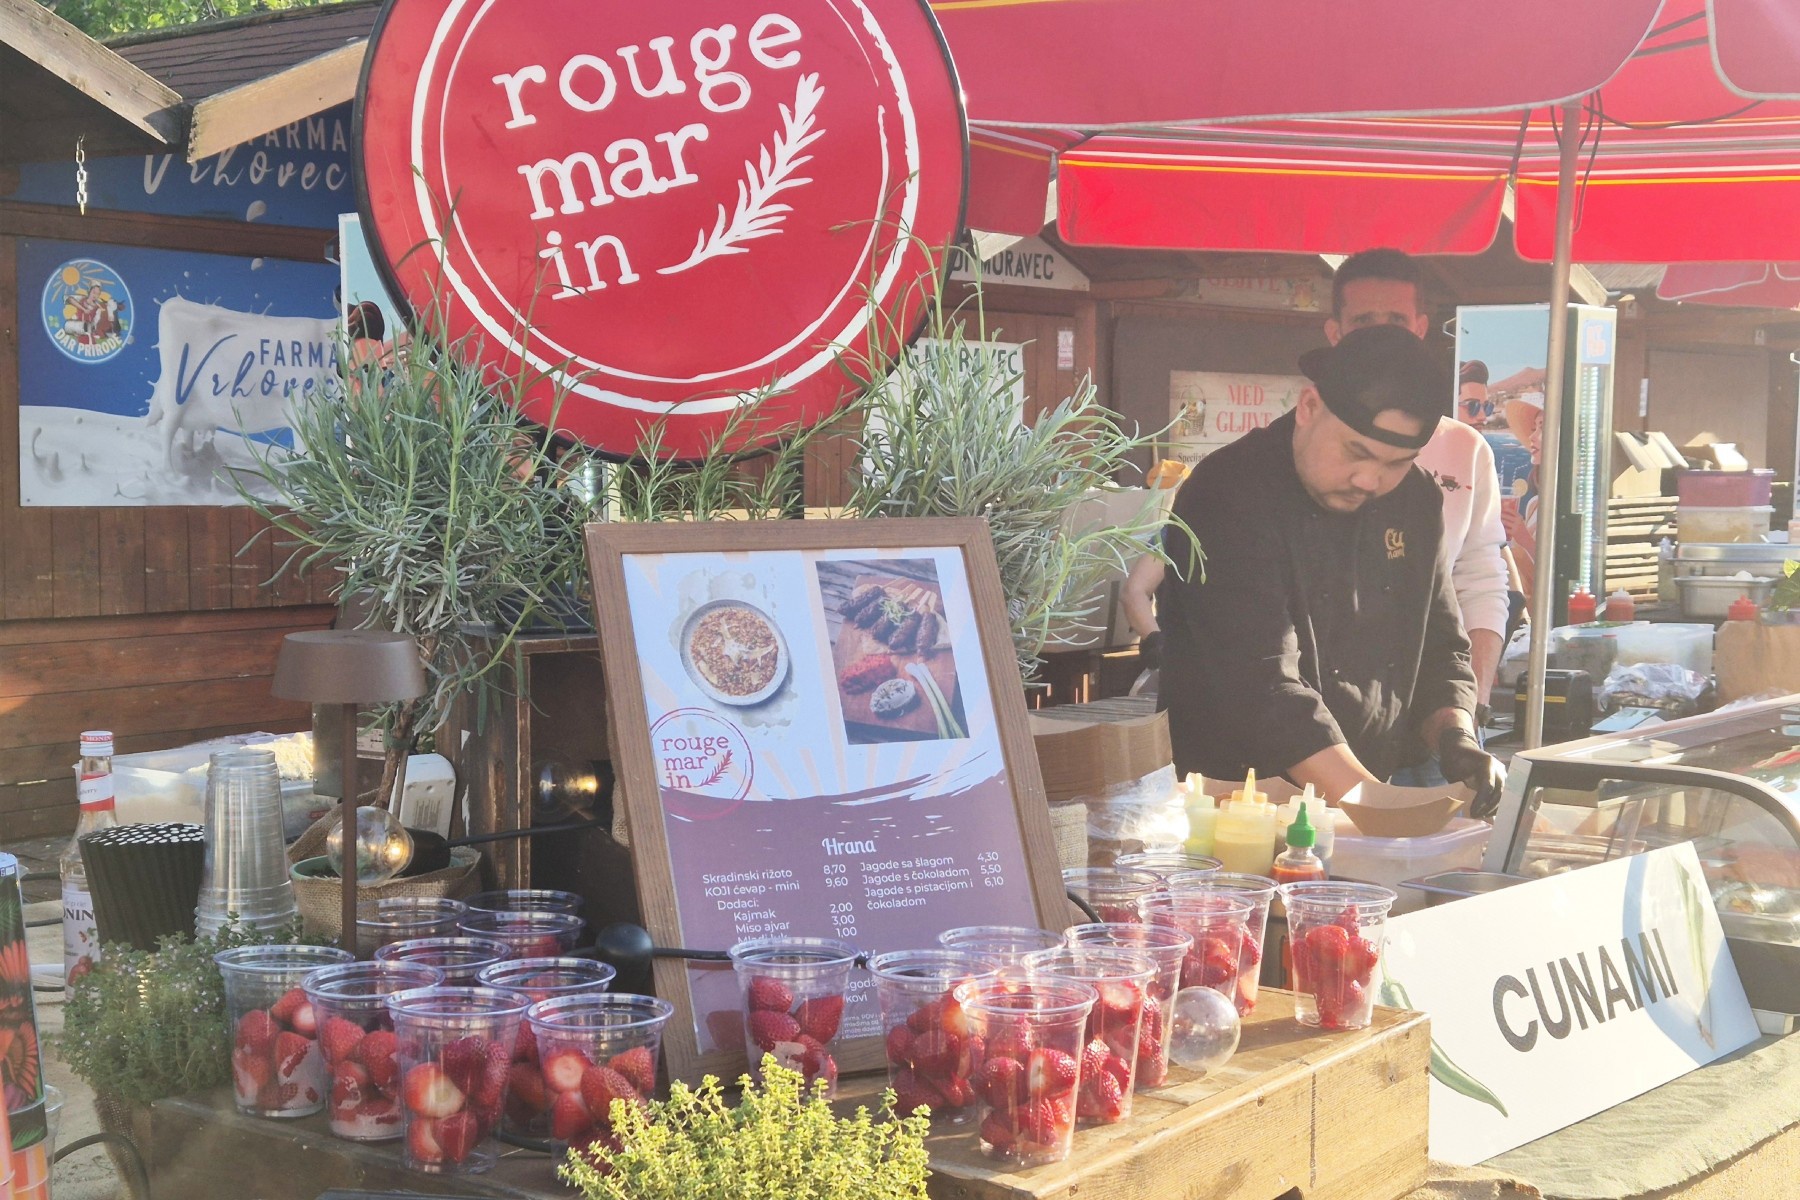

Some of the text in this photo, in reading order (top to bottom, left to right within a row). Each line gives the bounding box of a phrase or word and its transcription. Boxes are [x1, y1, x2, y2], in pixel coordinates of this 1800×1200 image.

[492, 13, 802, 129] rouge
[249, 116, 347, 152] ARMA
[517, 123, 709, 220] mar
[539, 230, 639, 300] in
[54, 328, 122, 357] DAR PRIRODE
[1228, 384, 1265, 406] MED
[661, 736, 729, 756] rouge
[664, 756, 708, 770] mar
[666, 772, 692, 788] in
[822, 838, 877, 856] Hrana
[860, 852, 999, 872] Jagode sa šlagom 4,30
[702, 864, 846, 884] Skradinski rižoto 8,70
[862, 873, 901, 885] Jagode
[912, 867, 970, 880] čokoladom
[980, 864, 1002, 875] 5,50
[705, 886, 731, 897] KOJI
[775, 880, 801, 892] mini
[825, 876, 848, 888] 9,60
[864, 885, 904, 897] Jagode
[906, 886, 912, 894] s
[914, 880, 968, 895] pistacijom
[984, 876, 1004, 887] 6,10
[63, 907, 94, 921] NIN
[717, 899, 760, 911] Dodaci:
[734, 902, 853, 923] Kajmak 2,00
[867, 897, 926, 911] čokoladom
[736, 914, 855, 934] Miso ajvar 3,00
[836, 927, 857, 938] 1,00
[1493, 928, 1679, 1053] CUNAMI
